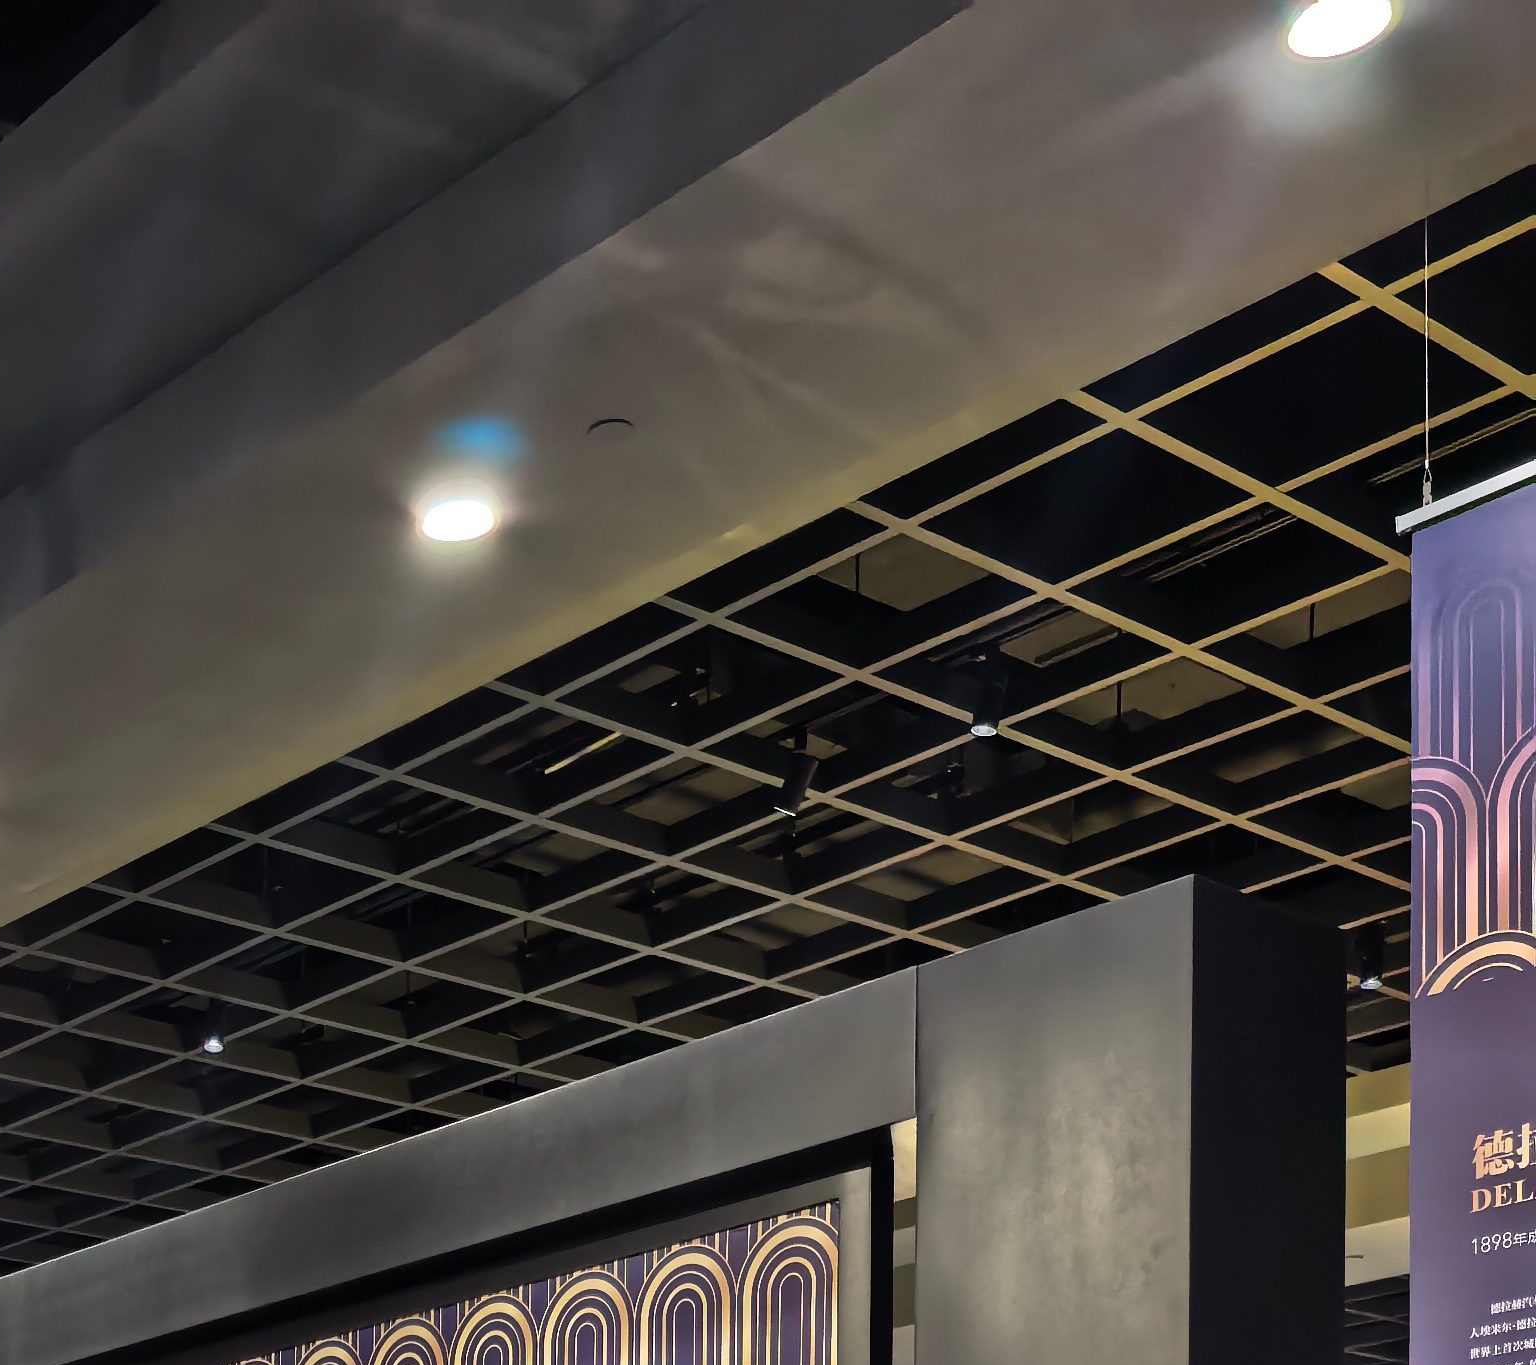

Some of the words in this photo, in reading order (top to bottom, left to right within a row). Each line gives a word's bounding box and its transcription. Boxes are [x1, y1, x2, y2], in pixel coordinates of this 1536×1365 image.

[1469, 1179, 1536, 1214] DEL
[1470, 1338, 1536, 1360] 世界上首次城
